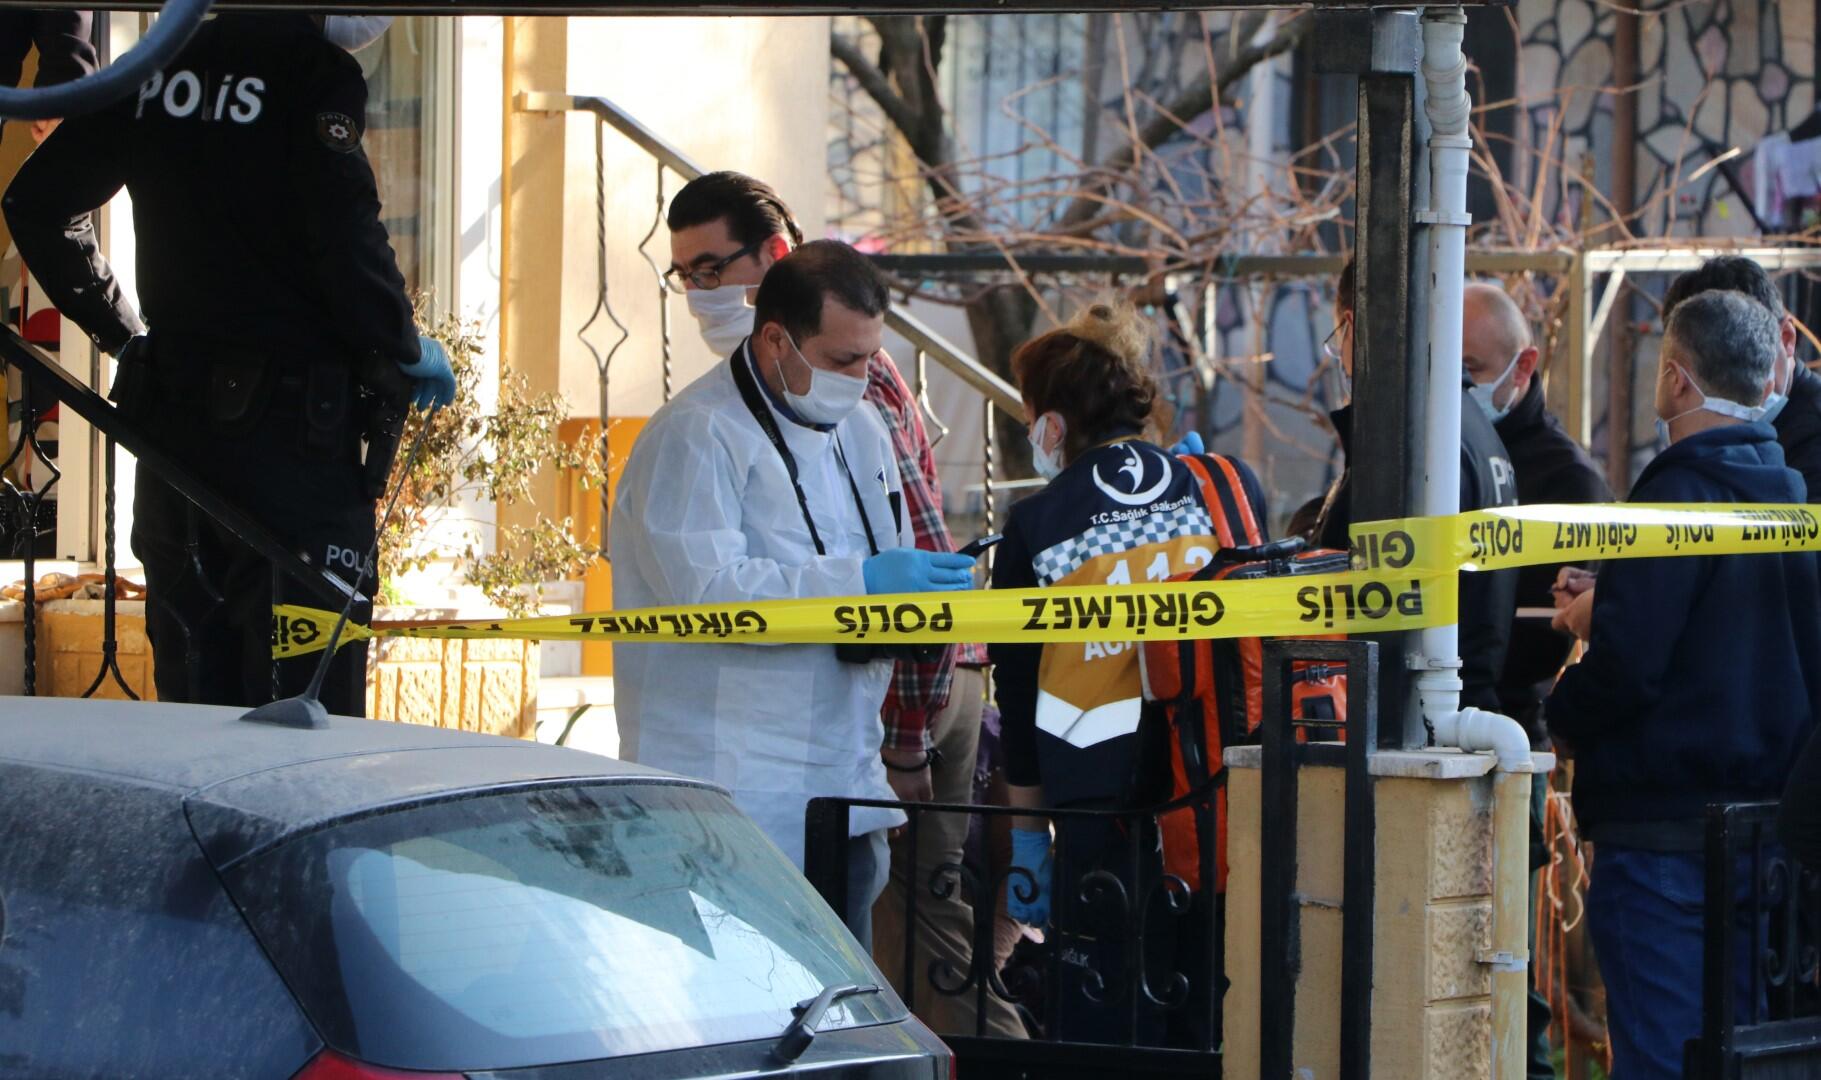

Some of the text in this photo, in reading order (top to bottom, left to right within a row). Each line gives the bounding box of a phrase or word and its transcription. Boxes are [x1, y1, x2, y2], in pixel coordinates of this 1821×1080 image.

[1469, 519, 1523, 565] POLİS
[570, 579, 1423, 639] POLİS GİRİLMEZ POLİS GİRİLMEZ
